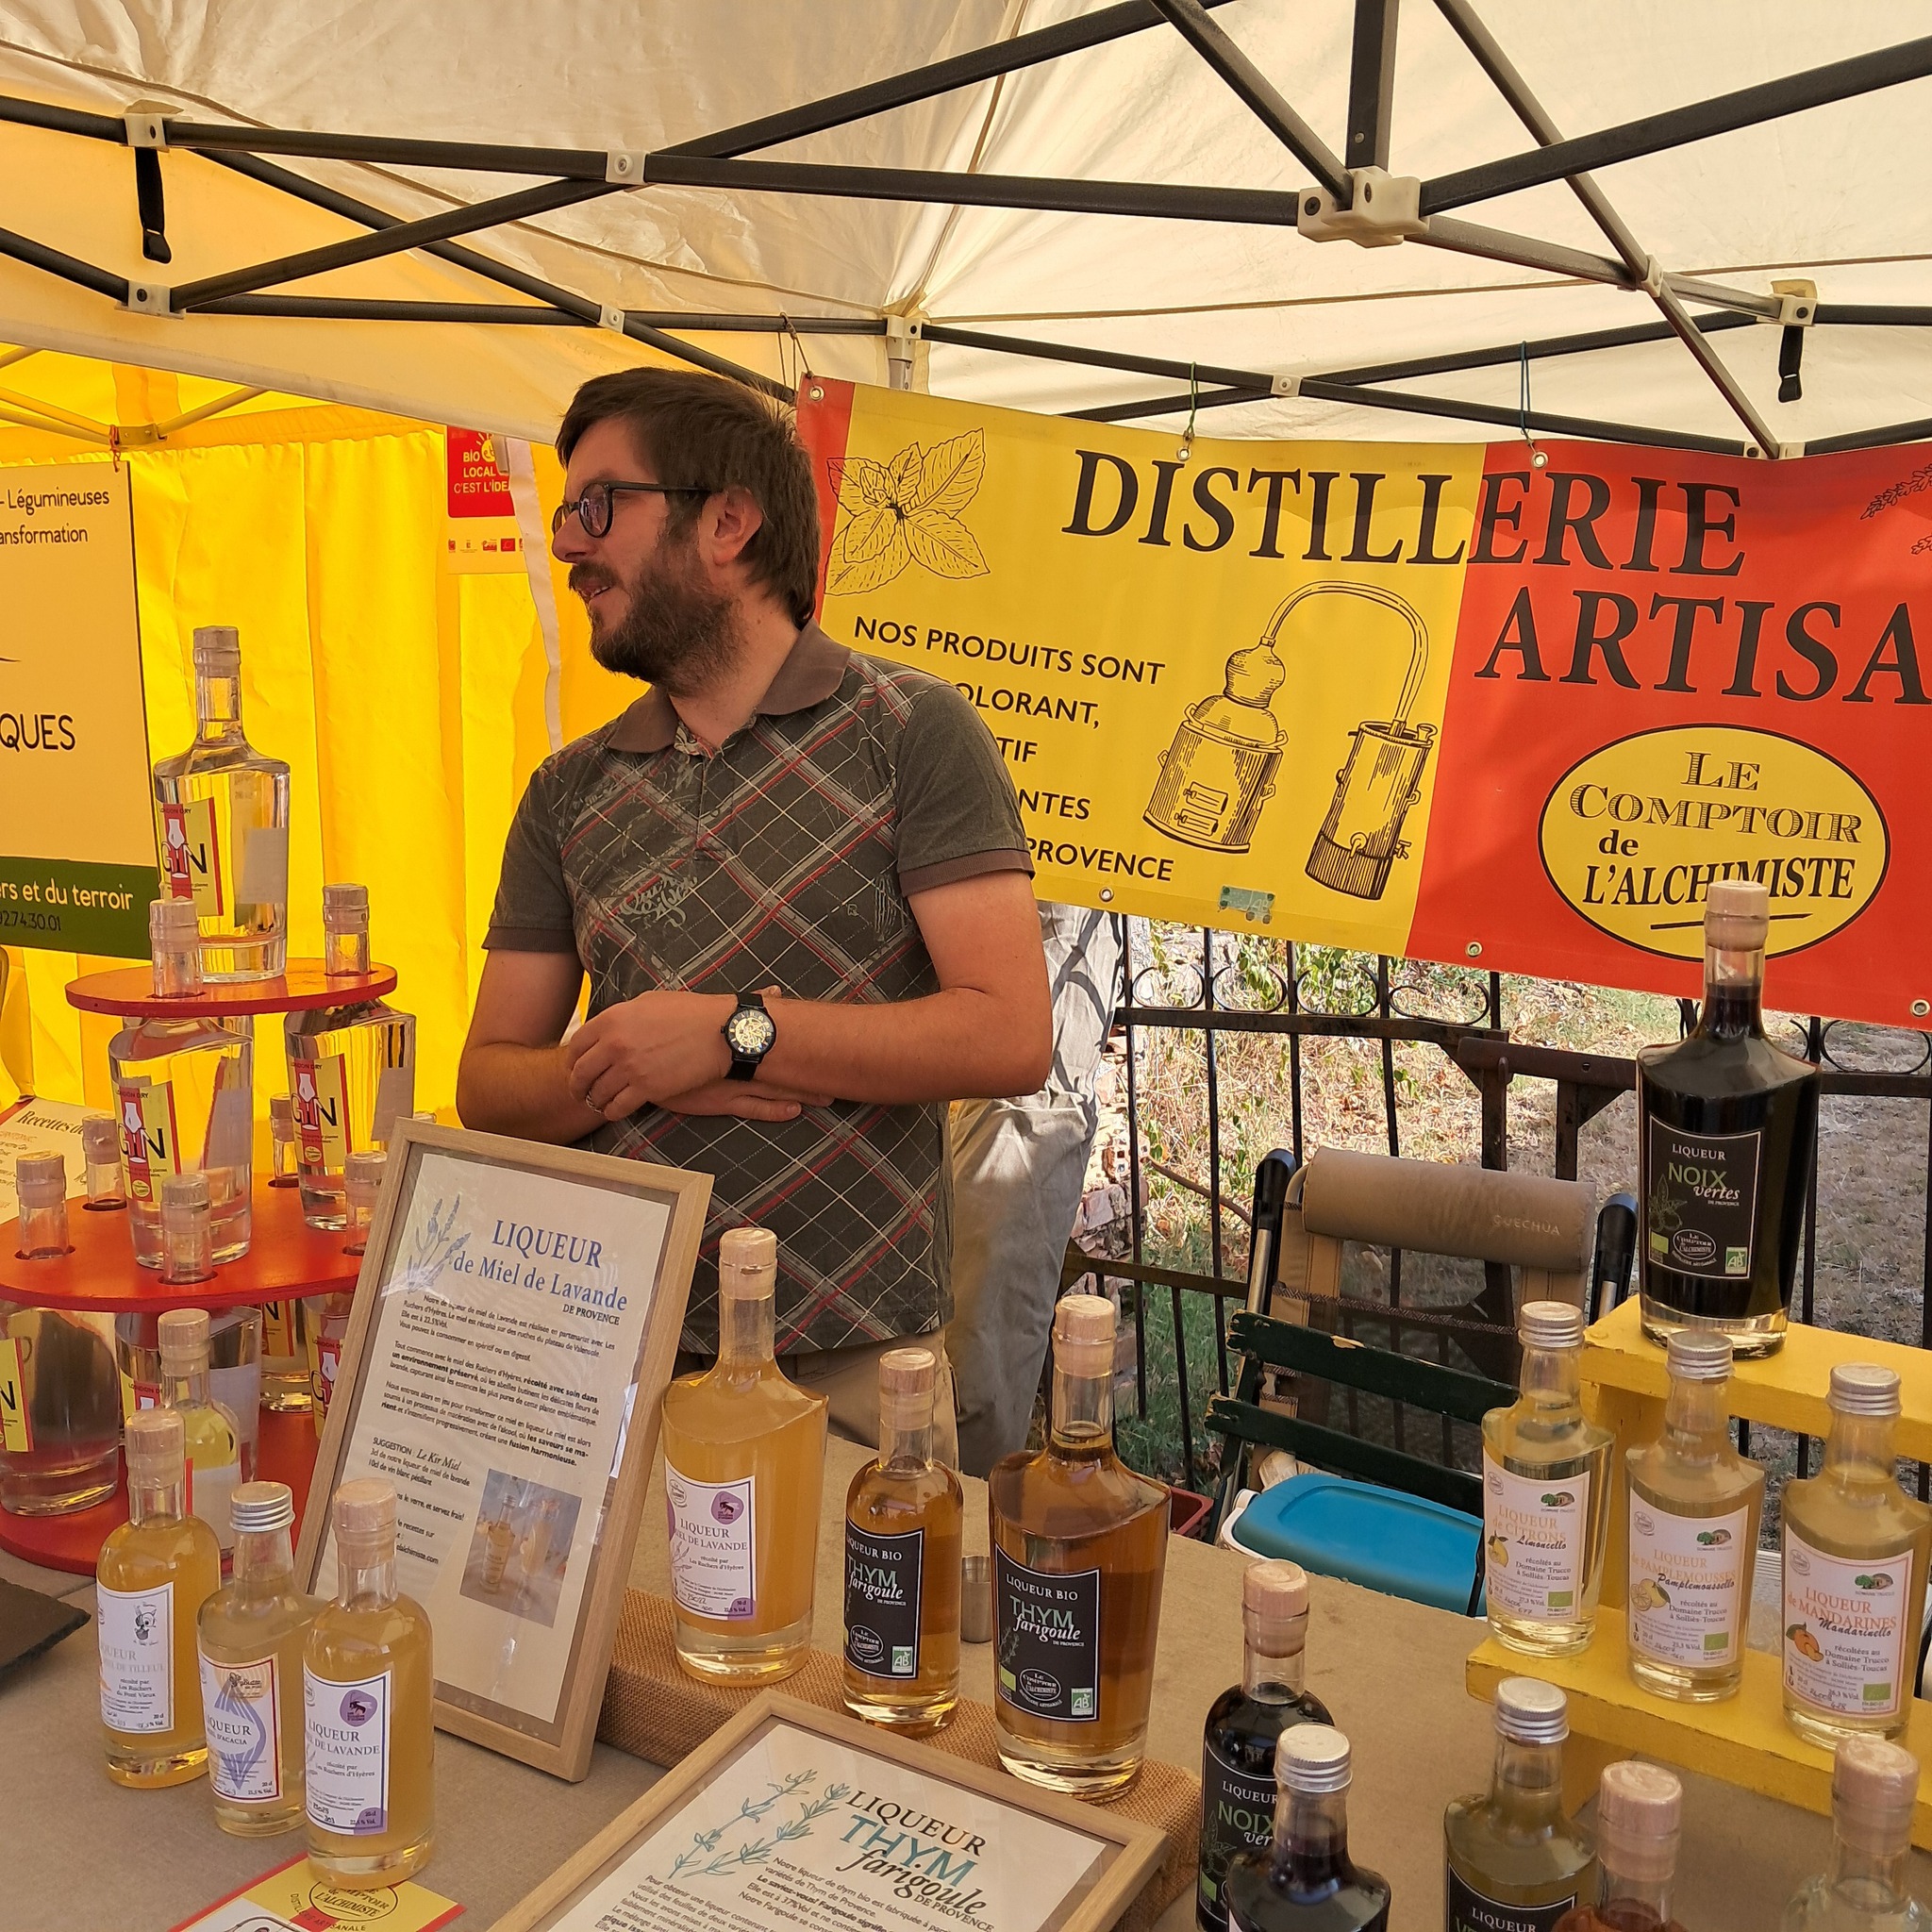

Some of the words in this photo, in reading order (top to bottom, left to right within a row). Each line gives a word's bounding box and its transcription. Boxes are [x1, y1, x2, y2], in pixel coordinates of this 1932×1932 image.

[463, 449, 480, 462] BIO
[463, 466, 496, 478] LOCAL
[8, 486, 110, 516] Légumineuses
[454, 481, 482, 494] C'EST
[1061, 449, 1746, 576] DISTILLERIE
[853, 615, 918, 649] NOS
[925, 628, 1074, 674] PRODUITS
[1080, 654, 1167, 686] SONT
[1474, 586, 1932, 706] ARTISA
[1680, 751, 1760, 791] LE
[1569, 783, 1862, 844] COMPTOIR
[161, 841, 208, 874] GIN
[1598, 830, 1640, 858] de
[23, 880, 41, 903] et
[45, 877, 68, 905] du
[72, 884, 133, 910] terroir
[16, 1110, 71, 1133] Recettes
[291, 1092, 338, 1126] GIN
[118, 1123, 166, 1158] GIN
[1672, 1143, 1726, 1160] LIQUEUR
[1668, 1161, 1728, 1189] NOIX
[1692, 1185, 1740, 1200] vertes
[491, 1219, 602, 1268] LIQUEUR
[453, 1248, 474, 1274] de
[477, 1256, 520, 1285] Miel
[523, 1266, 544, 1291] de
[549, 1273, 626, 1310] Lavande
[561, 1303, 575, 1314] DE
[575, 1306, 620, 1325] PROVENCE
[523, 1376, 547, 1389] récolté
[548, 1384, 564, 1394] avec
[580, 1392, 597, 1403] dans
[372, 1436, 412, 1455] SUGGESTION
[415, 1448, 427, 1459] Le
[426, 1452, 441, 1464] Kir
[508, 1439, 529, 1451] fusion
[680, 1518, 730, 1539] LIQUEUR
[1492, 1517, 1504, 1530] de
[1506, 1522, 1567, 1543] CITRONS
[1498, 1505, 1557, 1529] LIQUEUR
[689, 1537, 699, 1546] DE
[701, 1539, 748, 1551] LAVANDE
[881, 1550, 903, 1561] BIO
[1516, 1535, 1567, 1550] Limoncello
[847, 1553, 897, 1588] THYM
[1515, 1561, 1547, 1573] Domaine
[1654, 1548, 1707, 1568] LIQUEUR
[849, 1571, 904, 1601] farigoule
[1006, 1573, 1053, 1598] LIQUEUR
[1057, 1590, 1078, 1601] BIO
[1009, 1594, 1074, 1628] THYM
[1669, 1605, 1702, 1615] Domaine
[1799, 1598, 1897, 1629] MANDARINES
[1806, 1588, 1872, 1614] LIQUEUR
[1013, 1613, 1081, 1642] farigoule
[1819, 1617, 1891, 1638] Mandarinello
[894, 1655, 910, 1666] AB
[1824, 1650, 1861, 1662] Domaine
[1074, 1696, 1090, 1708] AB
[308, 1718, 360, 1742] LIQUEUR
[315, 1740, 325, 1751] DE
[327, 1743, 381, 1756] LAVANDE
[1222, 1780, 1277, 1805] LIQUEUR
[845, 1790, 986, 1857] LIQUEUR
[1217, 1801, 1276, 1834] NOIX
[840, 1814, 978, 1888] THYM
[773, 1857, 797, 1872] Notre
[798, 1867, 824, 1882] liqueur
[825, 1878, 836, 1888] de
[858, 1892, 871, 1904] bio
[872, 1899, 885, 1908] est
[835, 1848, 988, 1915] farigoule
[840, 1896, 876, 1919] Provence.
[913, 1894, 931, 1907] DE
[931, 1901, 995, 1932] PROVENCE
[1471, 1907, 1537, 1932] LIQUEUR
